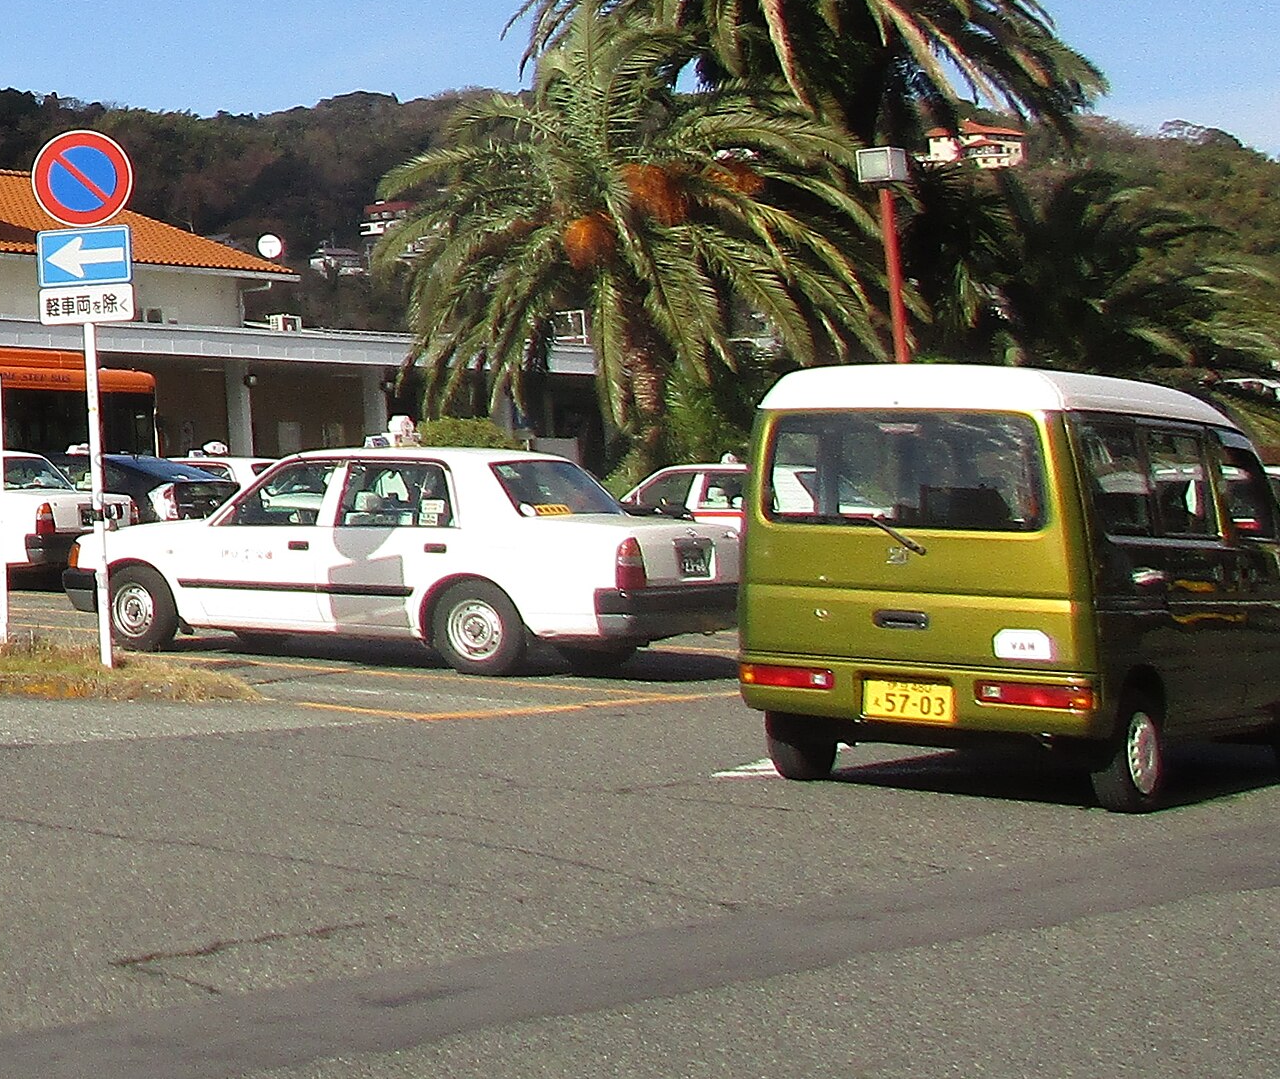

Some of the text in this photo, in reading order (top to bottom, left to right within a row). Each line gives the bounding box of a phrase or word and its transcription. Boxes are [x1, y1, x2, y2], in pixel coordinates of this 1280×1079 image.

[45, 292, 129, 318] 軽車両を除く
[1010, 641, 1035, 651] VAN
[885, 692, 945, 716] 57-03
